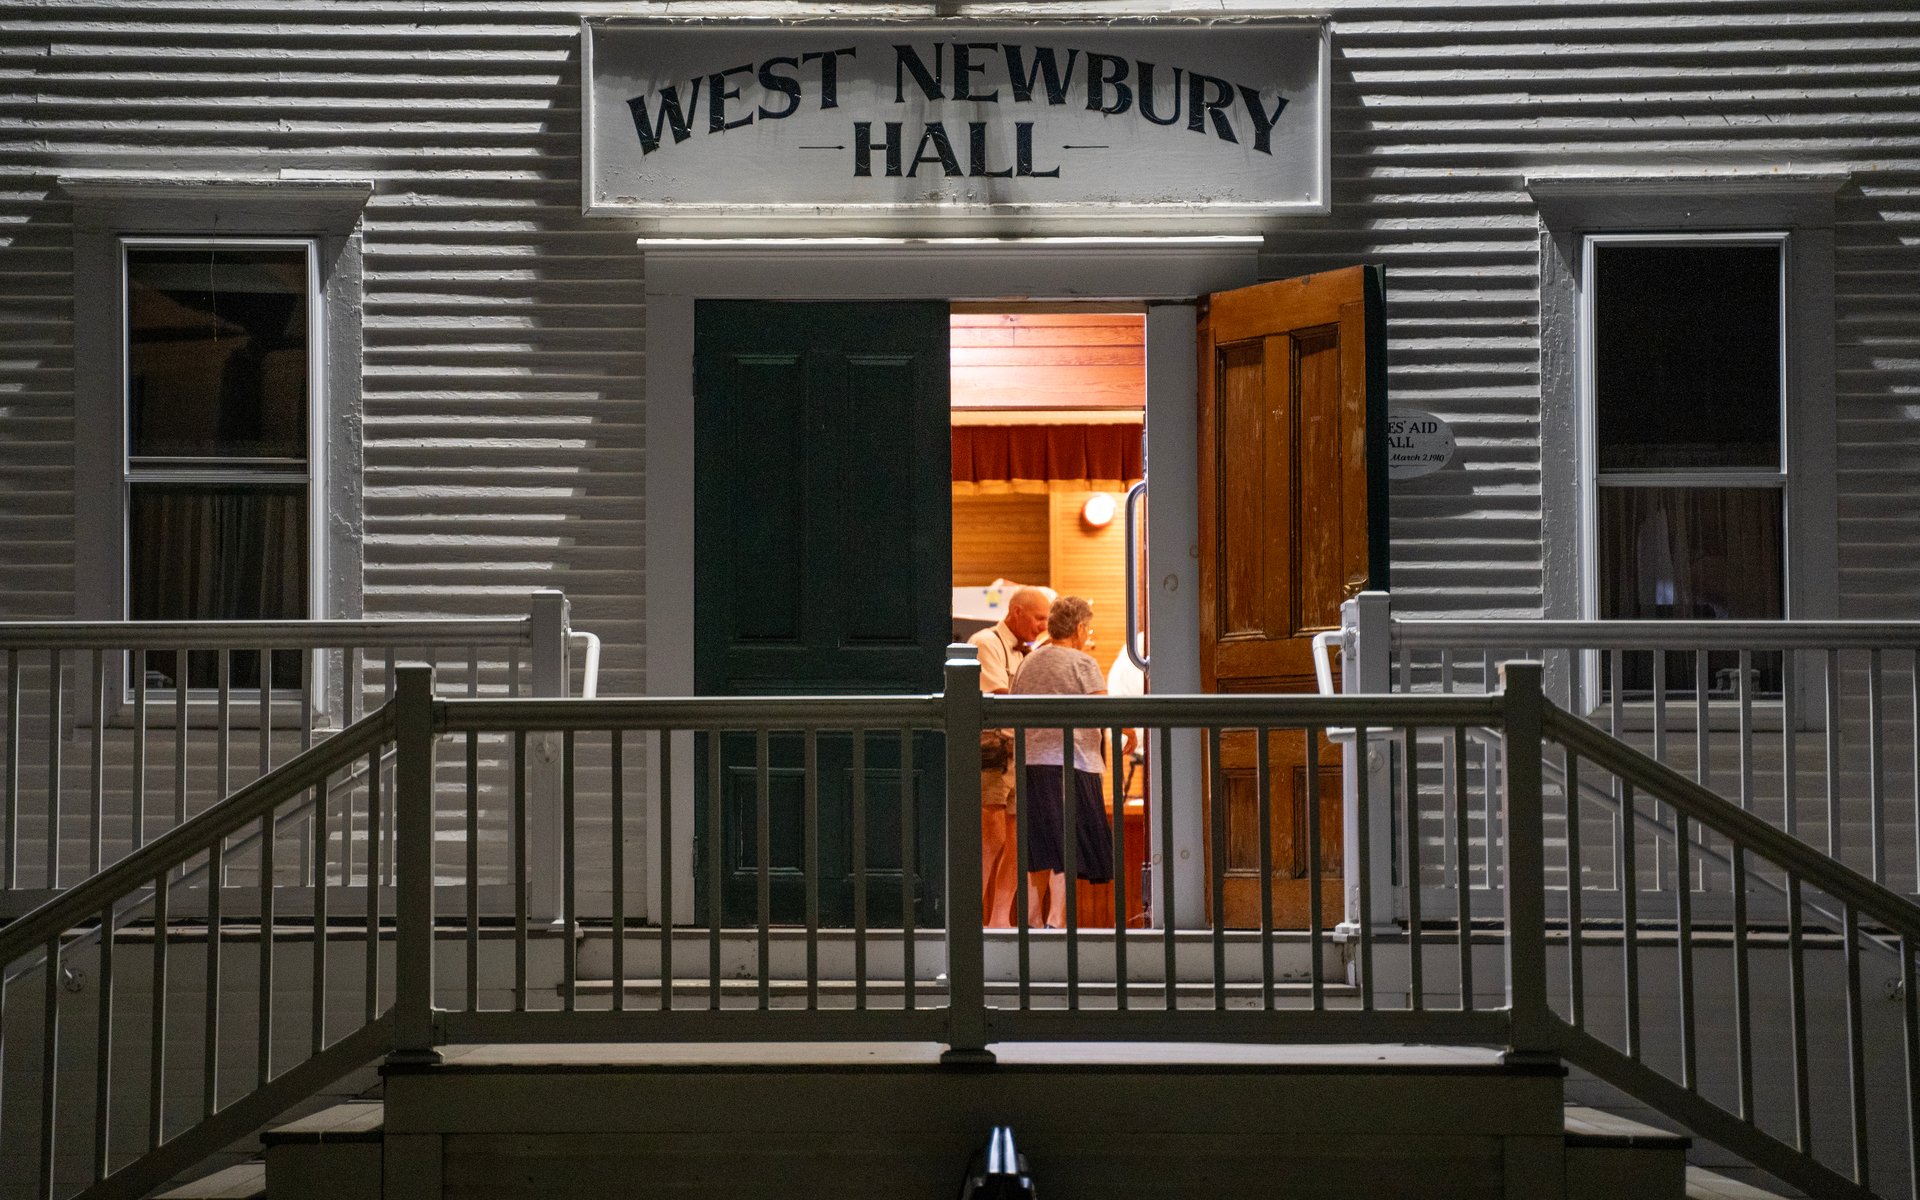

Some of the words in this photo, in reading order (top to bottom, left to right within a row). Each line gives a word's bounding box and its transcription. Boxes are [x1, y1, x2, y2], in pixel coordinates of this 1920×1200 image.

[626, 46, 856, 156] WEST
[892, 42, 1290, 156] NEWBURY
[853, 121, 1060, 178] HALL
[1409, 421, 1438, 434] AID
[1391, 453, 1420, 462] March
